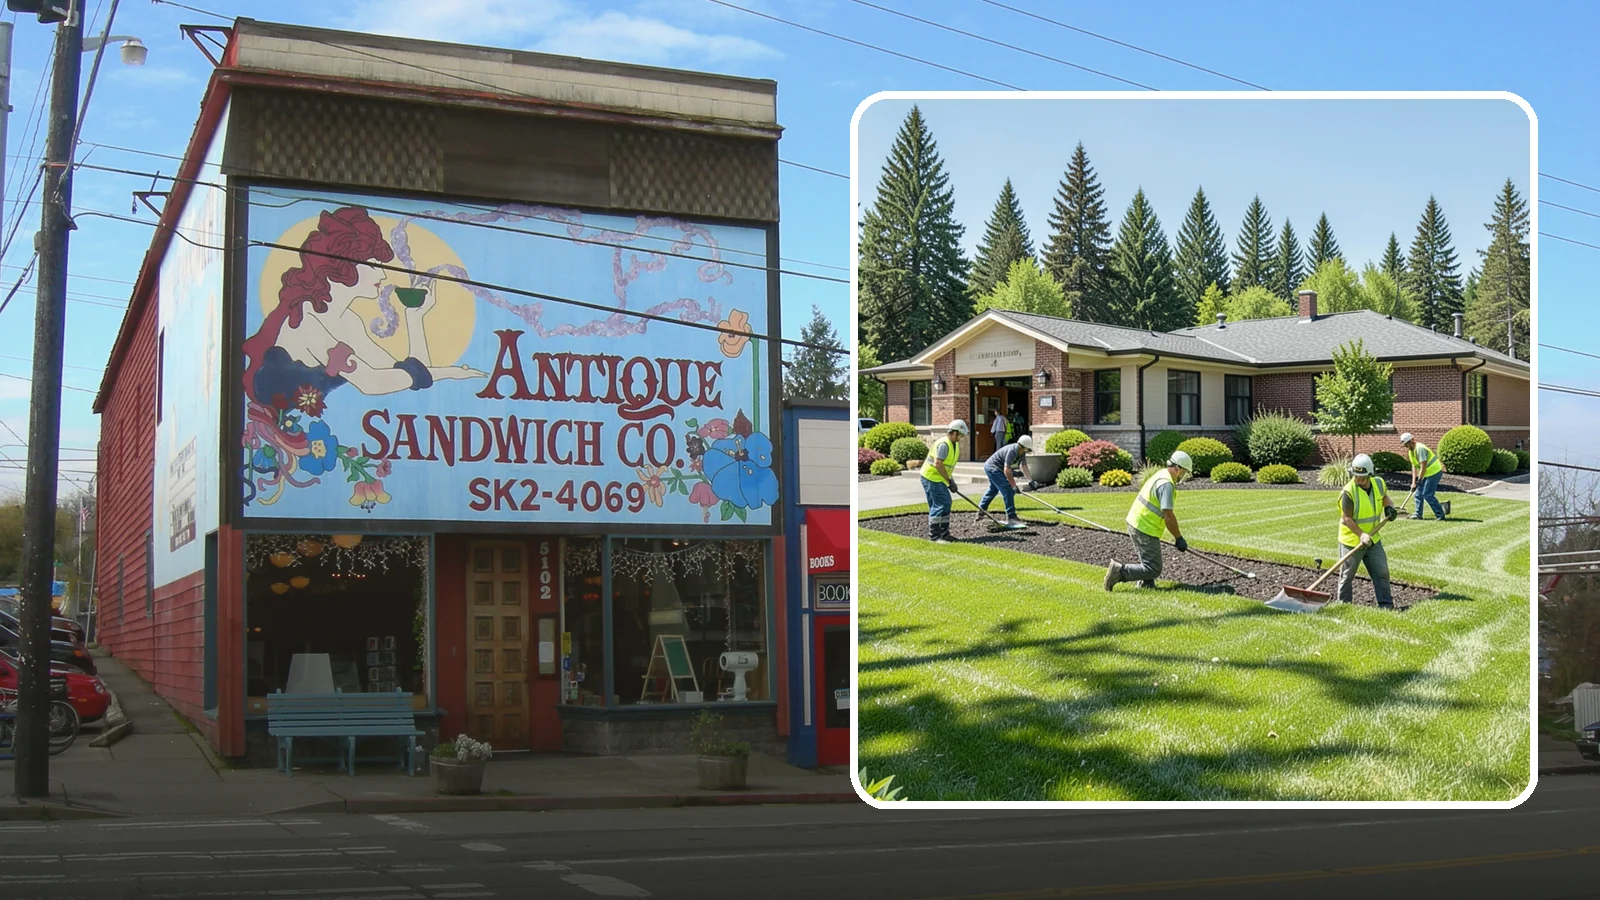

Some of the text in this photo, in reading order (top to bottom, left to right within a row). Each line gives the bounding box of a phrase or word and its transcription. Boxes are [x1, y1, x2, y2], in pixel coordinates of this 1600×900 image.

[476, 329, 723, 420] ANTIQUE
[361, 409, 685, 469] SANDWICH CO.
[469, 477, 646, 513] SK2-4069
[540, 541, 551, 599] 5102
[810, 555, 835, 569] BOOKS
